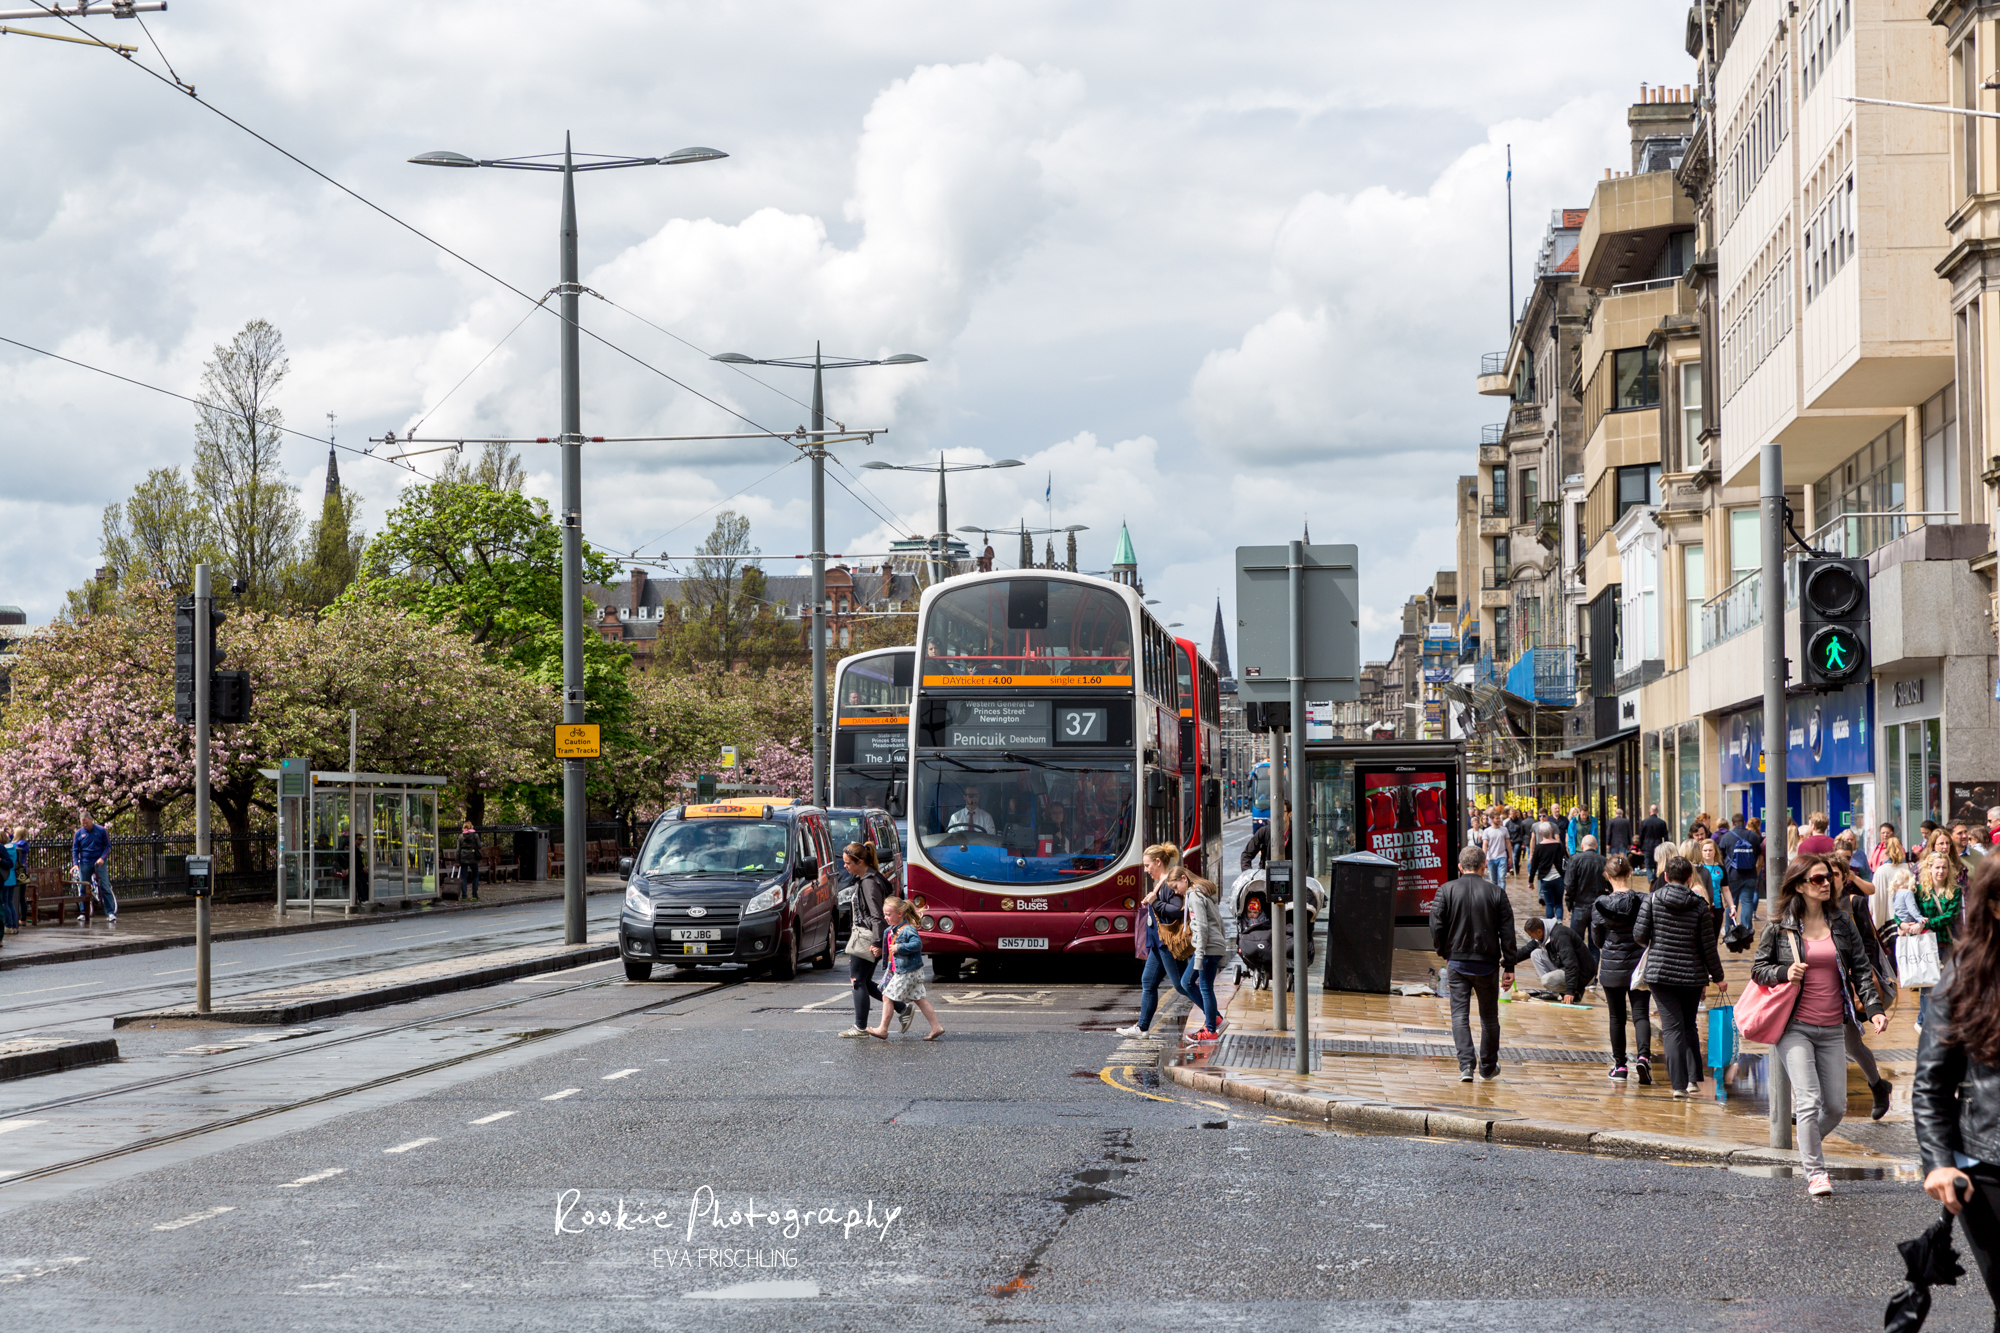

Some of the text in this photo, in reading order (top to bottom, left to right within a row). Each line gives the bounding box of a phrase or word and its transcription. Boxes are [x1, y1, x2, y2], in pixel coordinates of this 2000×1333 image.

[1050, 676, 1101, 685] single £1.60
[1066, 712, 1096, 736] 37
[954, 733, 1046, 746] Penicuik Deanburn
[865, 754, 883, 763] The
[1372, 830, 1439, 848] REDDER,
[1376, 845, 1435, 860] HOTTER,
[1399, 857, 1441, 871] SOMER
[1117, 875, 1136, 886] 840
[1017, 900, 1048, 910] Buses
[681, 931, 711, 939] V2 JBG
[1002, 939, 1045, 947] SN57 DDJ
[1899, 953, 1933, 965] next
